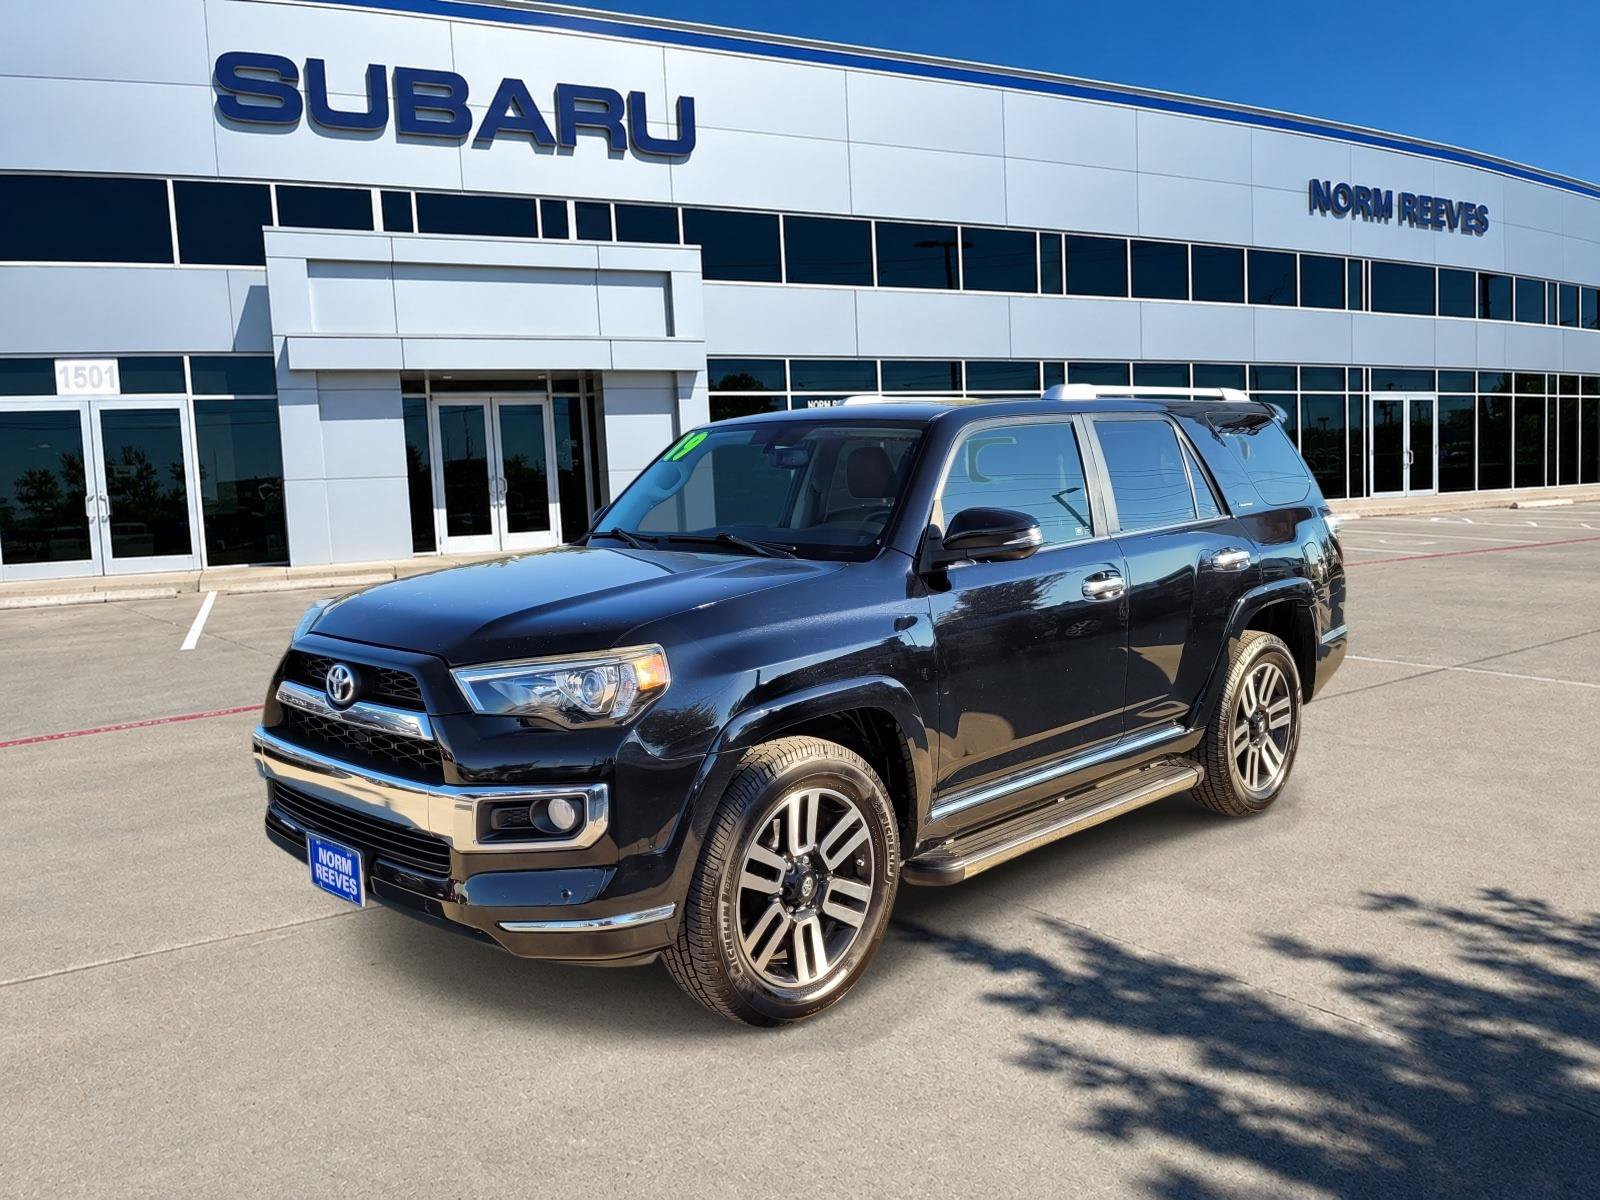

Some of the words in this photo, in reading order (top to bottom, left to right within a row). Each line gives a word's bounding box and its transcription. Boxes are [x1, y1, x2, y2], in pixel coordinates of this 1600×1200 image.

[214, 51, 696, 157] SUBARU
[1308, 178, 1394, 221] NORM
[1398, 192, 1490, 234] REEVES
[59, 364, 115, 389] 1501
[315, 862, 358, 896] REEVES
[318, 846, 352, 876] NORM
[722, 905, 742, 974] MICHELIN
